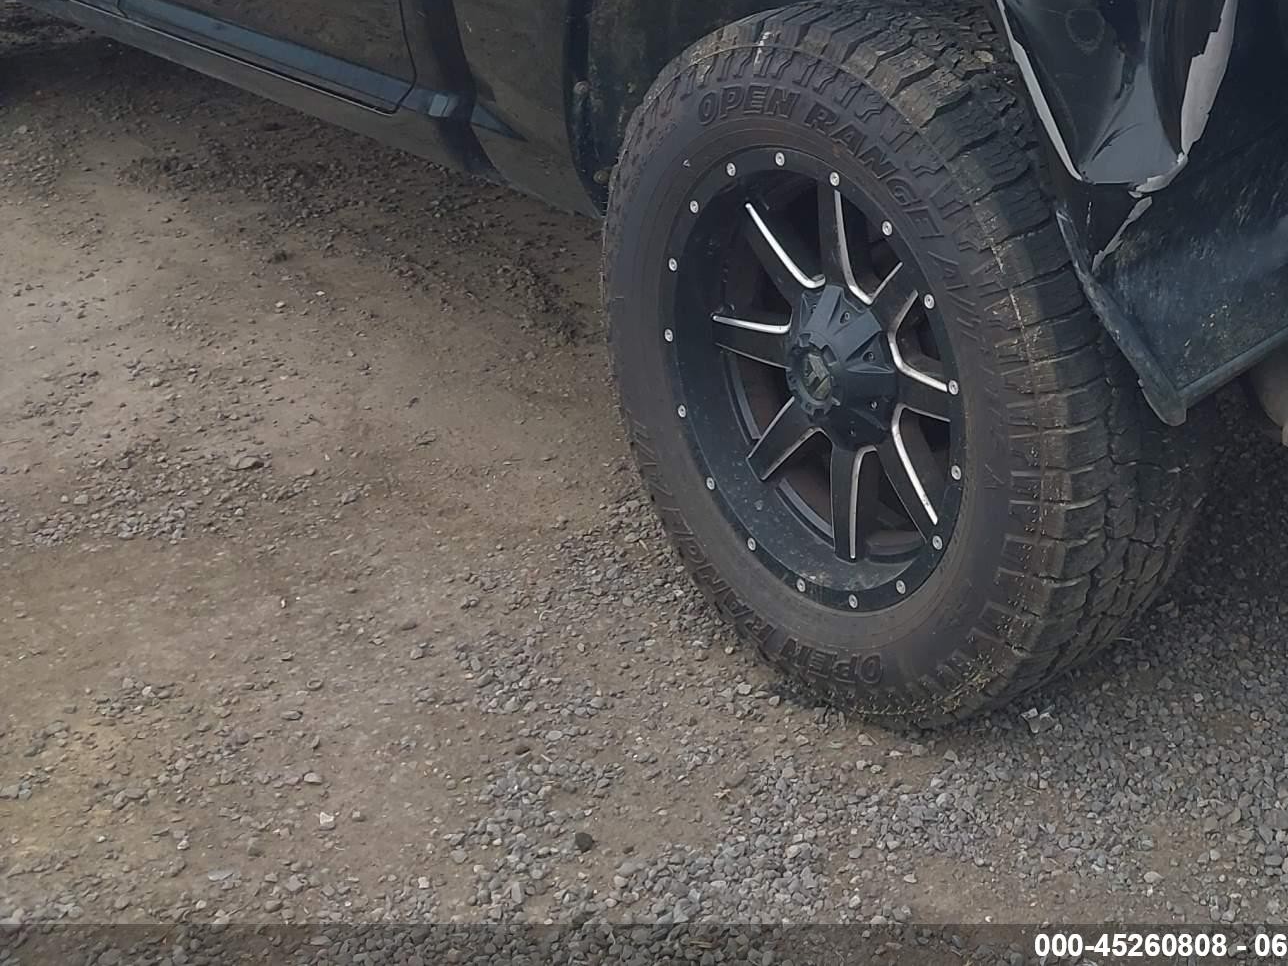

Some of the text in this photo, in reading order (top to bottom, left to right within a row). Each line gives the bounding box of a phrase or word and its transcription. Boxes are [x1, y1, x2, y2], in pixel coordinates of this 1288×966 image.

[697, 84, 801, 126] OPEN
[803, 100, 945, 239] RANGE
[779, 638, 883, 684] OPEN
